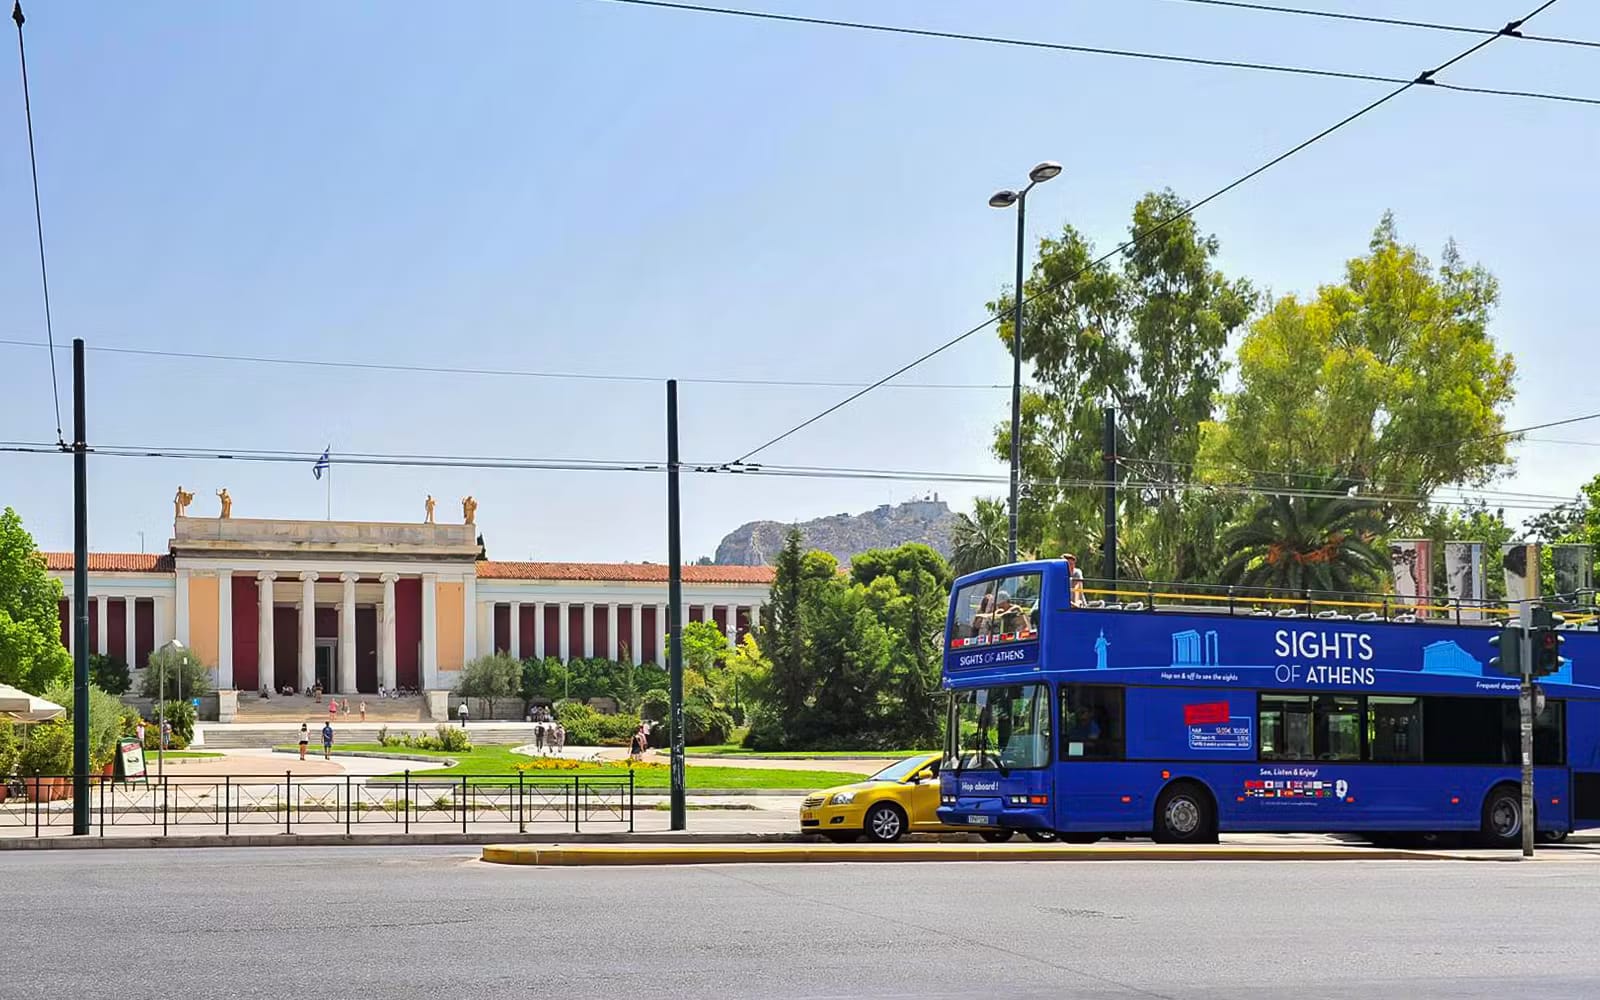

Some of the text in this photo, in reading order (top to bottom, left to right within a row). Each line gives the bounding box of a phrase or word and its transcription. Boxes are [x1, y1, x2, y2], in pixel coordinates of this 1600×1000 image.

[1275, 629, 1373, 660] SIGHTS
[960, 649, 1024, 666] SIGHTS OF ATHENS
[1161, 672, 1172, 680] Hop
[1187, 672, 1195, 680] off
[1223, 673, 1238, 682] sights
[1275, 664, 1375, 685] OF ATHENS
[1476, 681, 1500, 690] Frequent
[1299, 768, 1318, 778] Enjoy!
[961, 781, 974, 792] Hop
